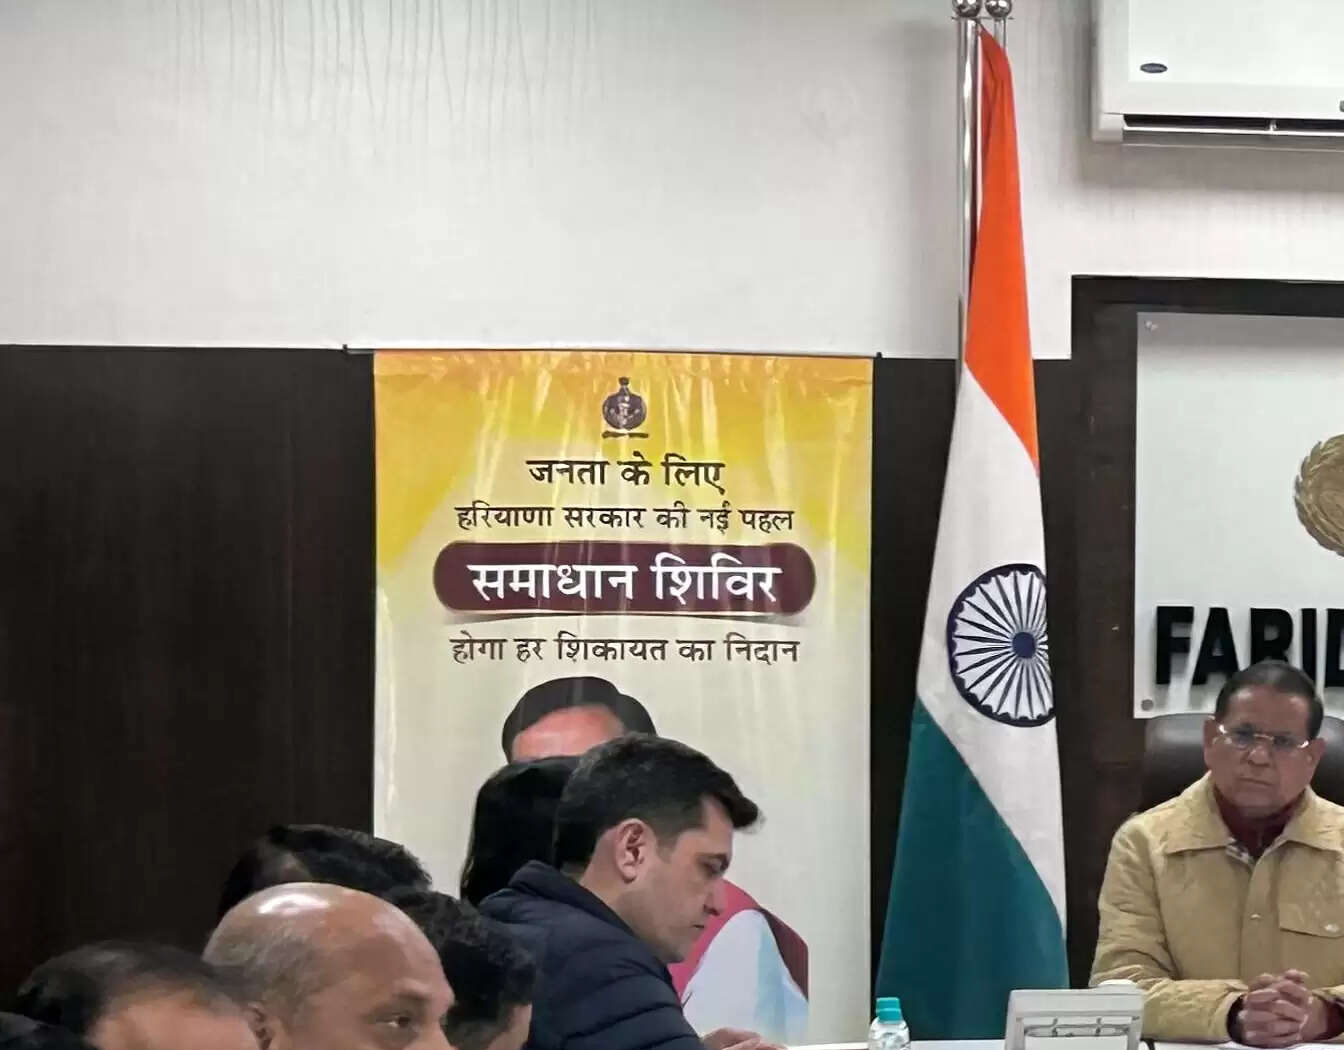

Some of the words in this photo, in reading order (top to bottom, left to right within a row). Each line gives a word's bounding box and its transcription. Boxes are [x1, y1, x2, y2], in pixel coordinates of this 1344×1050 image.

[525, 460, 610, 485] जनता
[616, 450, 653, 486] के
[660, 452, 726, 496] लिए
[454, 499, 555, 531] हरियाणा
[562, 507, 647, 528] सरकार
[652, 500, 691, 529] की
[696, 500, 732, 533] नई
[737, 509, 795, 534] पहल
[466, 563, 640, 602] समाधान
[649, 552, 783, 606] शिविर
[449, 630, 508, 664] होगा
[513, 638, 547, 662] हर
[553, 630, 669, 662] शिकायत
[675, 639, 716, 662] का
[723, 632, 801, 665] निदान
